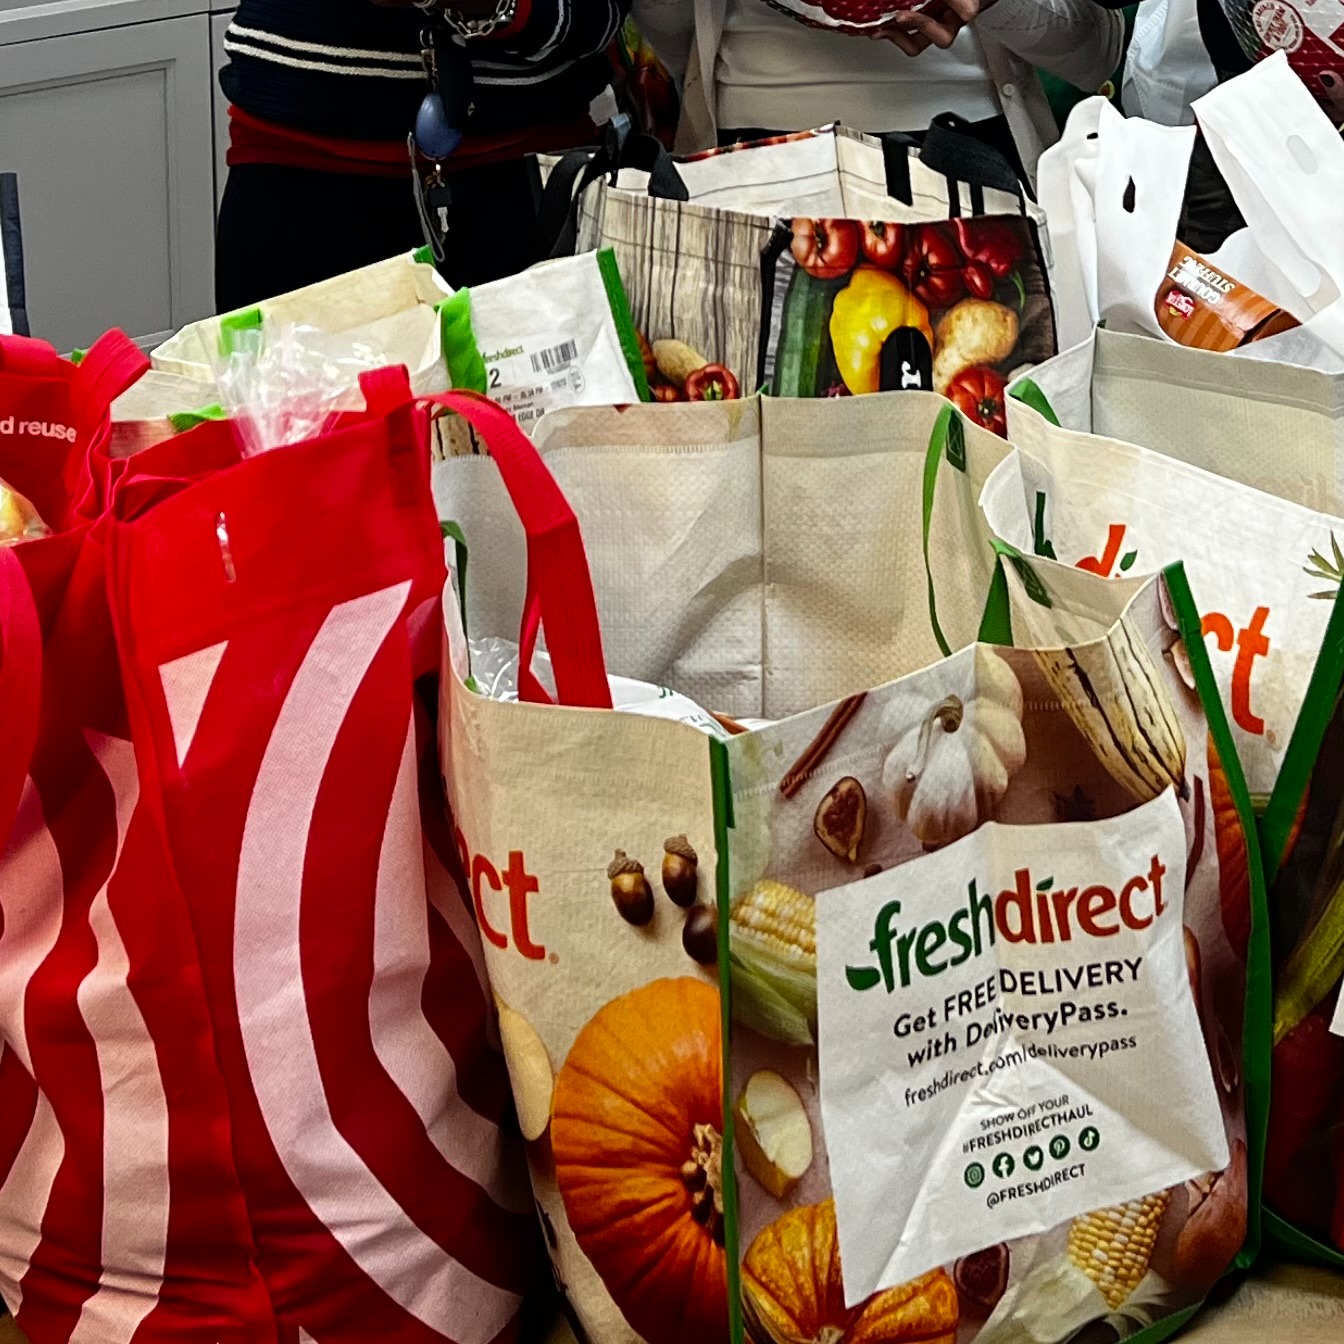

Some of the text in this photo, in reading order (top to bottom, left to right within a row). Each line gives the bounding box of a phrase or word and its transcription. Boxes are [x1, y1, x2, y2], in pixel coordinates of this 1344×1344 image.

[488, 367, 502, 389] 2
[18, 416, 78, 444] reuse
[846, 854, 1168, 994] freshdirect
[893, 956, 1144, 1038] Get FREE DELIVERY
[906, 999, 1129, 1069] with DeliveryPass.
[904, 1034, 1138, 1108] freshdirect.com/deliverypass
[962, 1103, 1095, 1154] #FRESHDIRECTHAUL
[980, 1094, 1070, 1132] SHOW OFF YOUR
[986, 1162, 1086, 1211] @FRESHDIRECT
